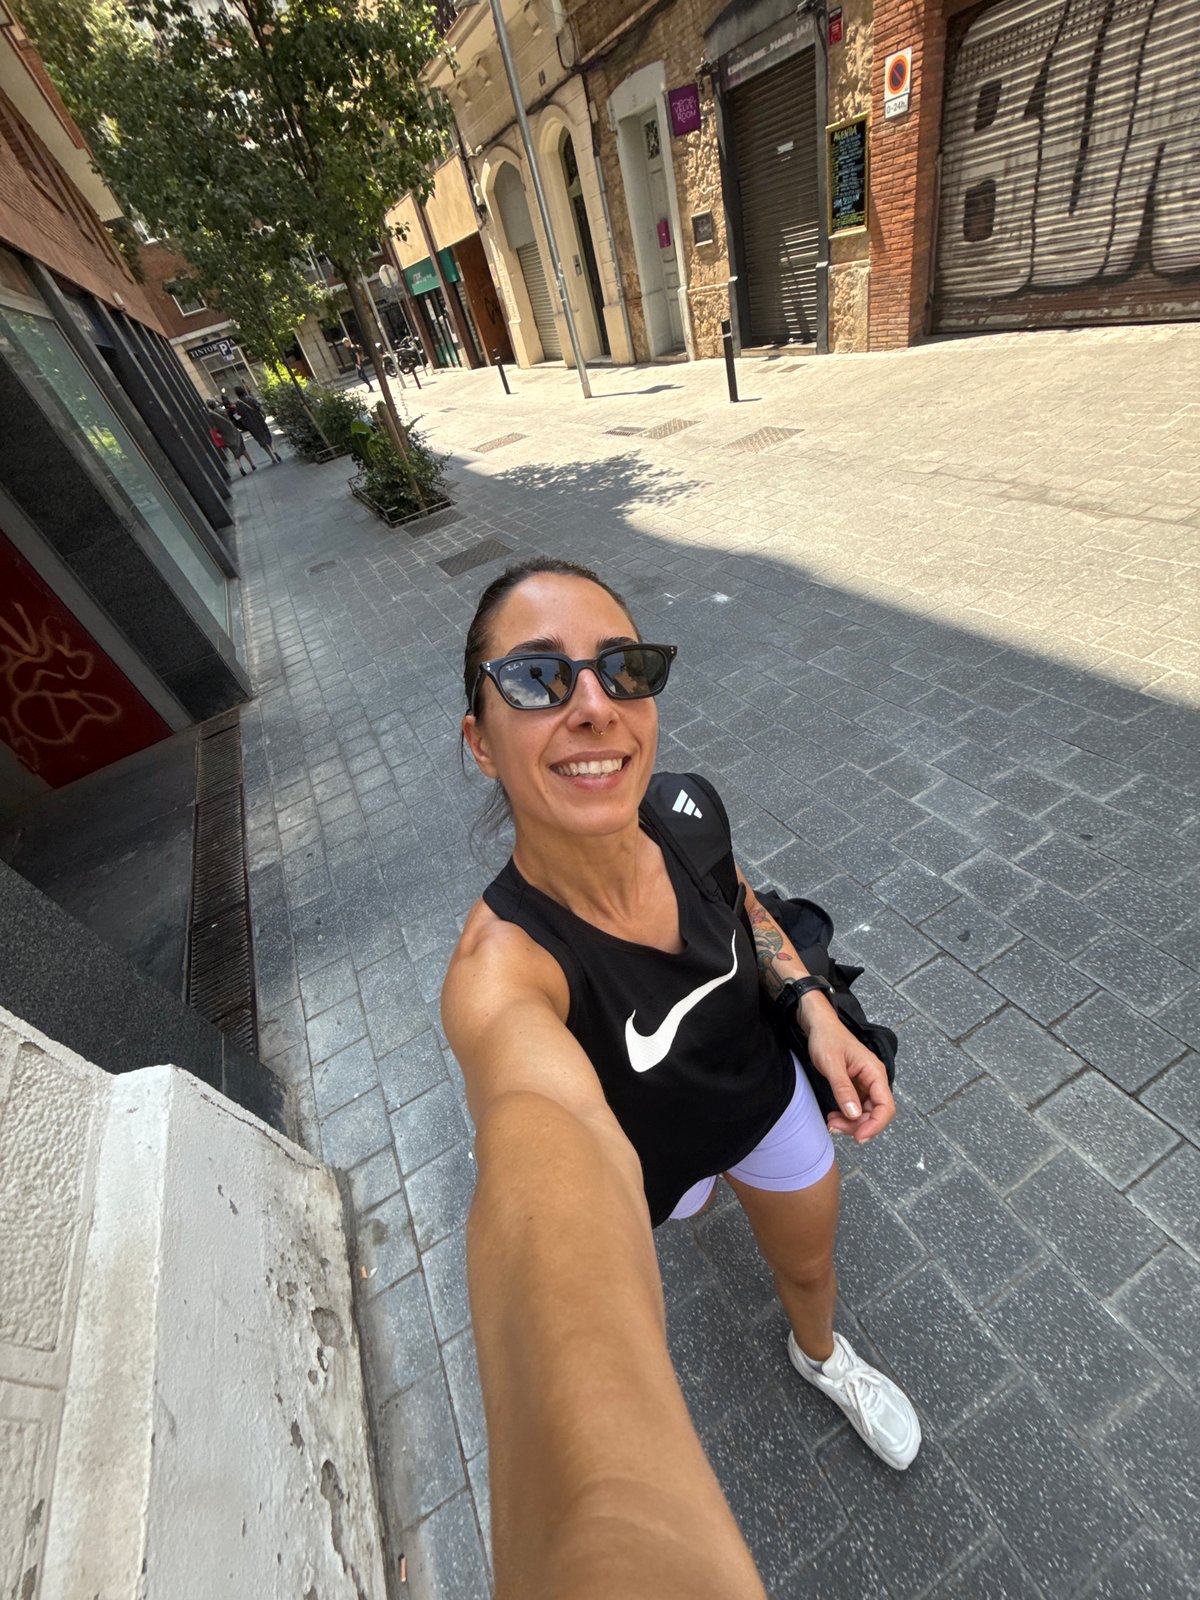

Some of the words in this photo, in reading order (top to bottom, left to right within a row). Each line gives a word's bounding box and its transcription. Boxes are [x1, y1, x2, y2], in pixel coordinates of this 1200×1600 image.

[674, 99, 697, 114] VELVET
[677, 109, 697, 123] ROOM
[218, 343, 228, 355] P
